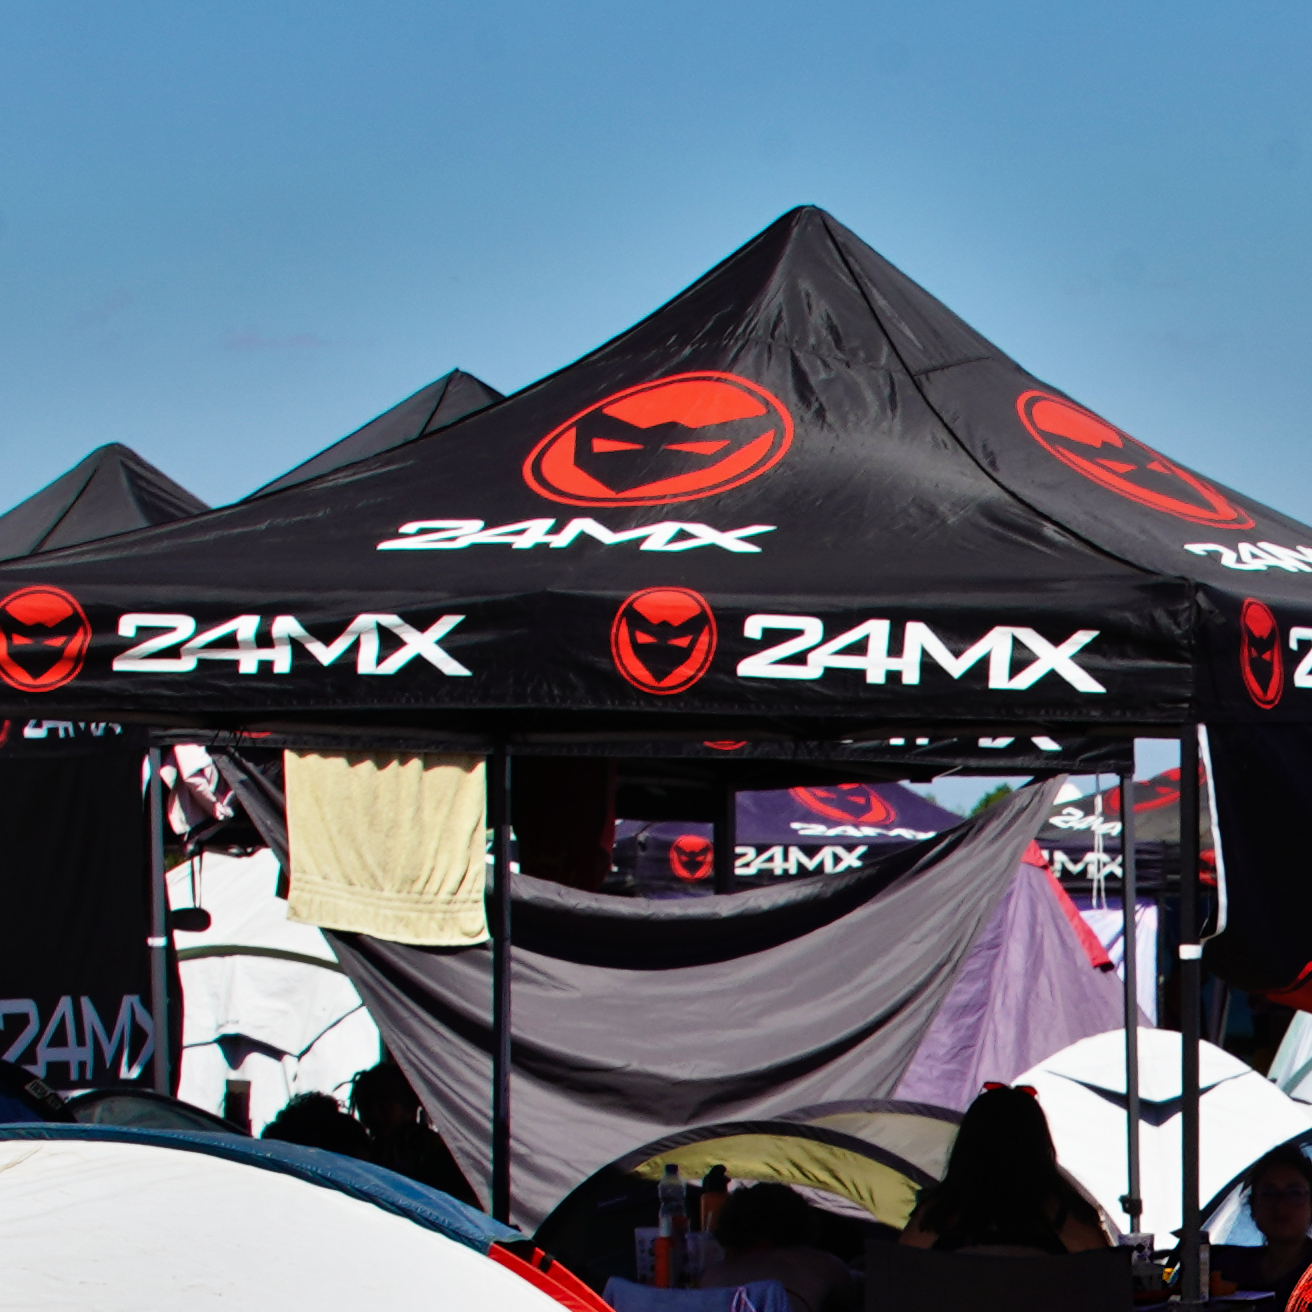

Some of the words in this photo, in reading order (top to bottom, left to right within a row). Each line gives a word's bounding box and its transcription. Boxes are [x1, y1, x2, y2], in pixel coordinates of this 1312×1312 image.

[376, 517, 778, 552] 24MX
[112, 613, 473, 677] 24MX
[736, 613, 1107, 694] 24MX
[734, 844, 869, 876] 24MX
